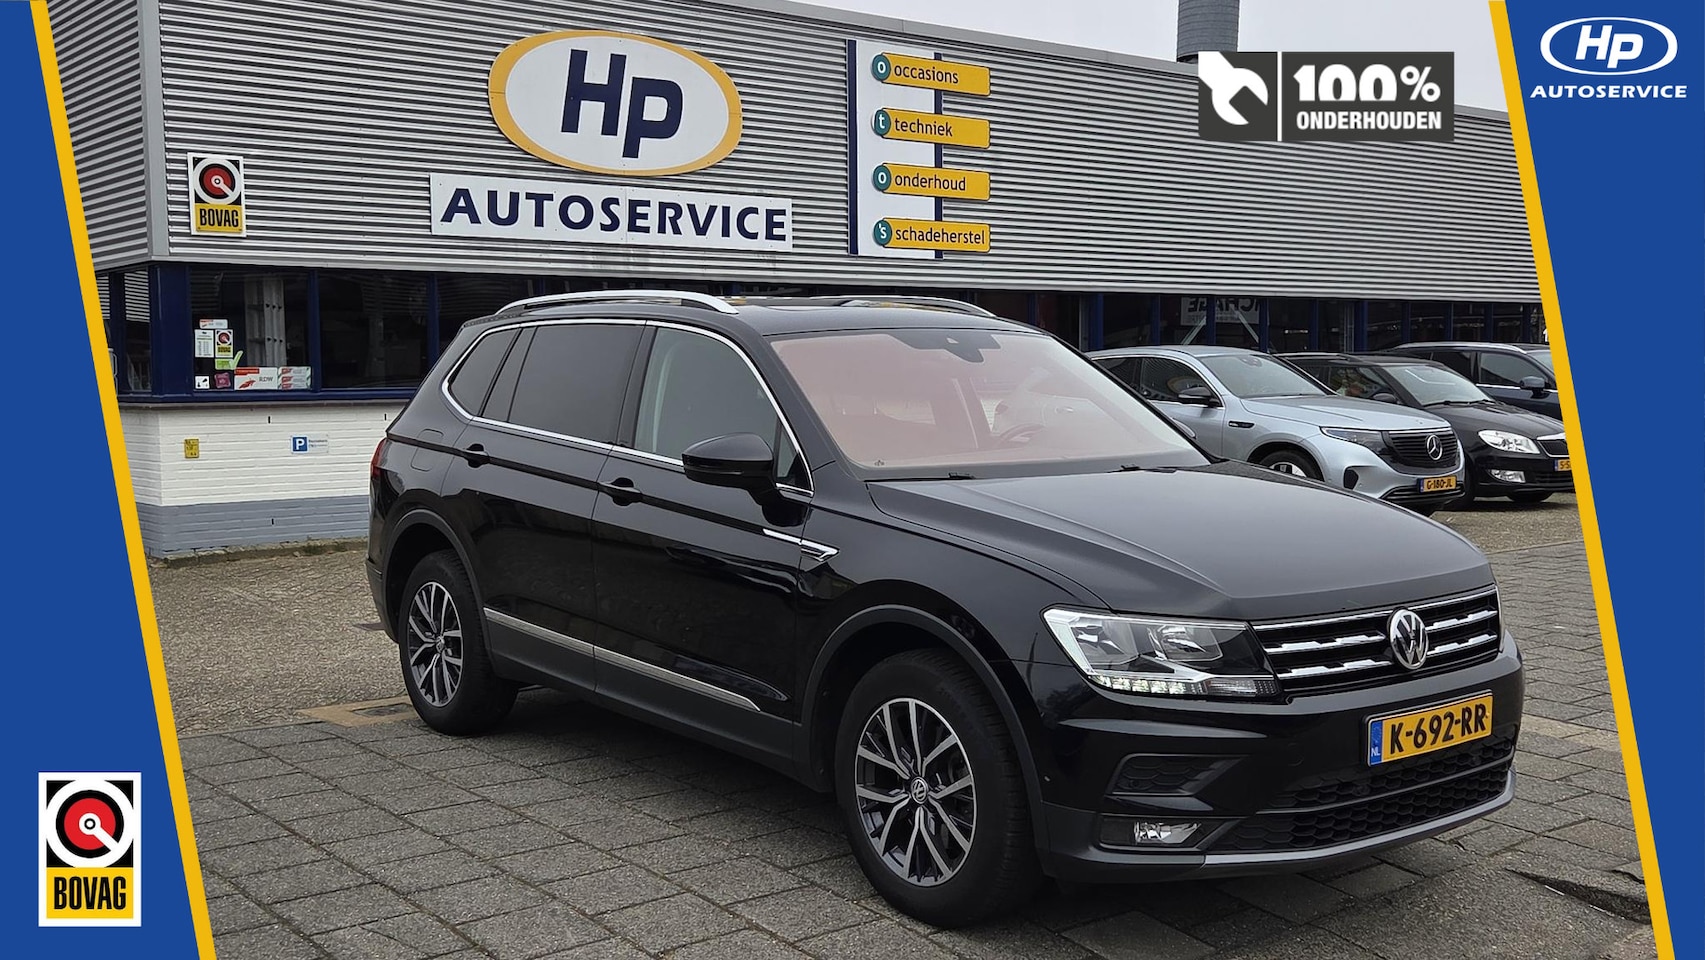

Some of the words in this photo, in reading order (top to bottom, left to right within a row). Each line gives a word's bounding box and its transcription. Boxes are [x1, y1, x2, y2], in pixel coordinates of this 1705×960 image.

[894, 65, 959, 84] occasions
[560, 48, 683, 159] Hp
[894, 117, 953, 137] techniek
[894, 173, 966, 191] onderhoud
[199, 208, 239, 228] BOVAG
[440, 188, 787, 241] AUTOSERVICE
[895, 226, 985, 244] schadeherstel
[1390, 703, 1487, 755] K-692-RR
